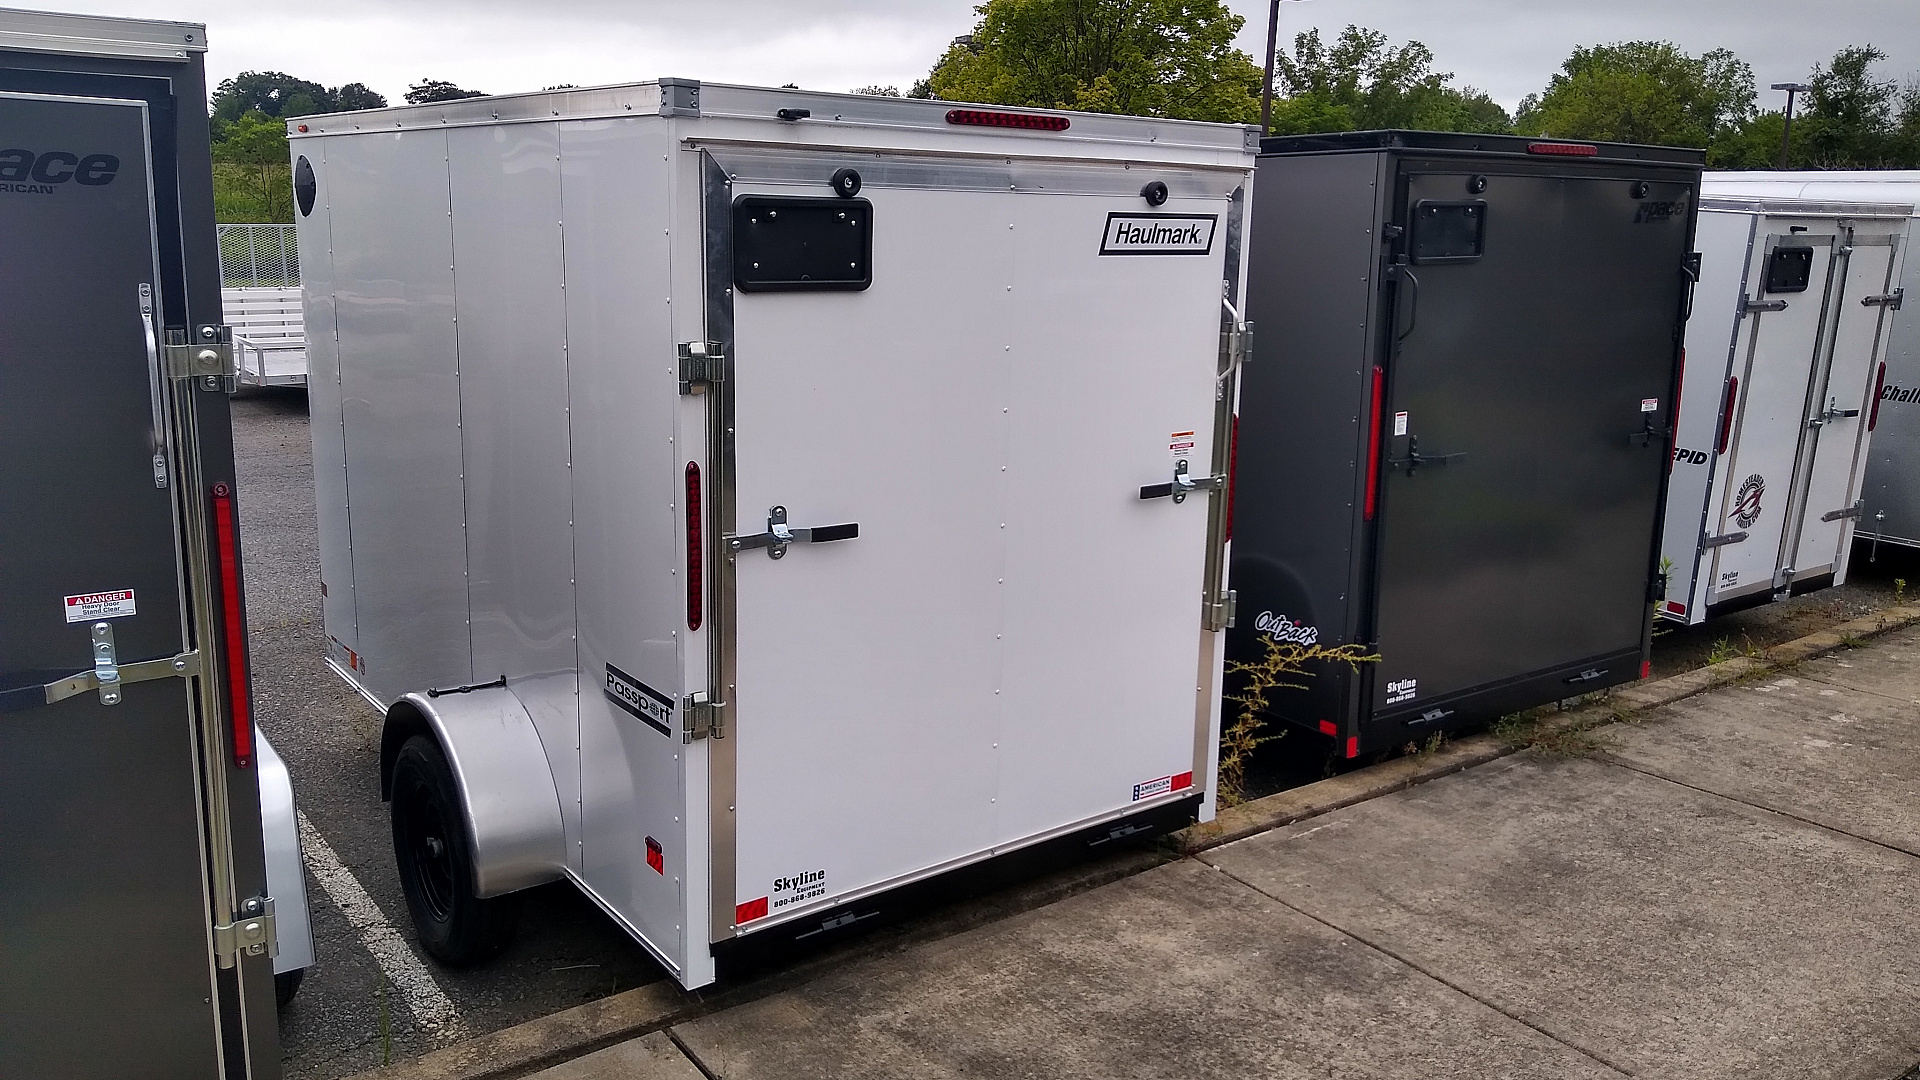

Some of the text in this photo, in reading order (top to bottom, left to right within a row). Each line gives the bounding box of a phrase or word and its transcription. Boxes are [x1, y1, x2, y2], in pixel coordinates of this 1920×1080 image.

[1115, 222, 1200, 245] Haulmark
[1881, 385, 1920, 404] Chall
[84, 592, 126, 604] DANGER
[82, 607, 102, 615] Stand
[1387, 679, 1417, 693] Skyline
[606, 671, 671, 724] Passport
[1140, 780, 1170, 792] AMERICAN
[773, 869, 825, 892] Skyline
[773, 888, 826, 908] 800-868-9826
